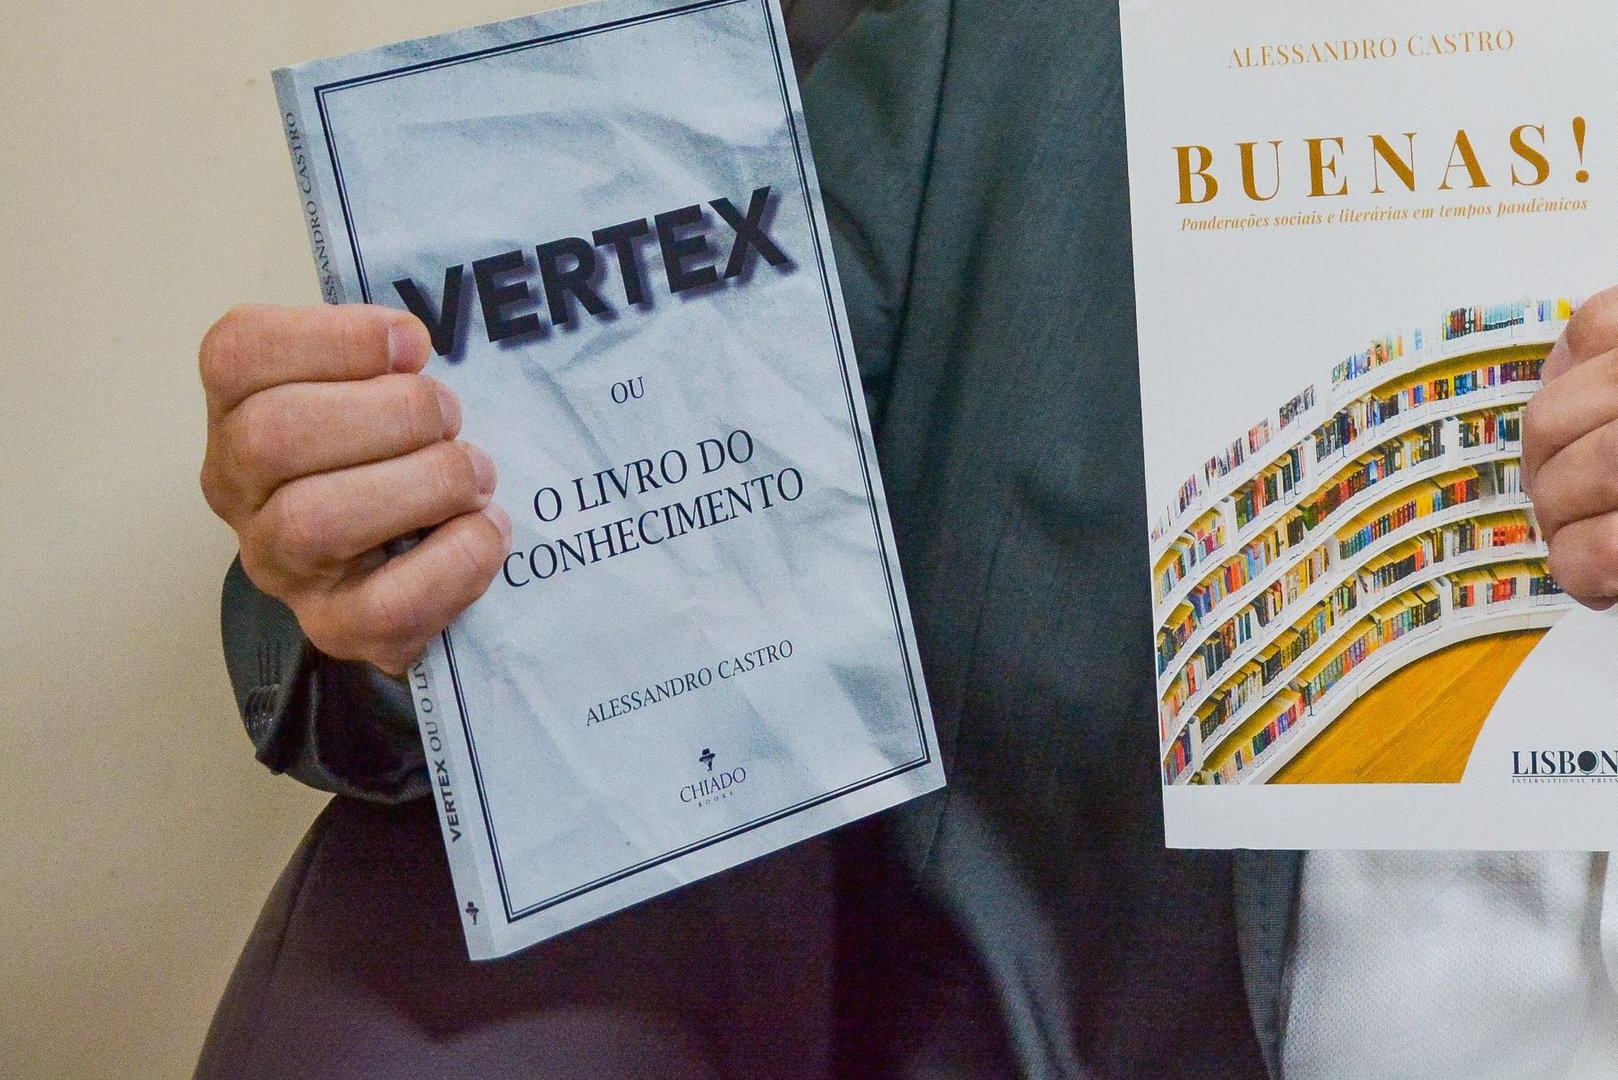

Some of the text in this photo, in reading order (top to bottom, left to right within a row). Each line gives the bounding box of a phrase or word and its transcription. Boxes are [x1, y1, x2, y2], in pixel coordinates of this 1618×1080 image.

[1228, 28, 1515, 70] ALESSANDRO CASTRO
[1172, 115, 1591, 205] BUENAS!
[285, 111, 339, 305] ESSANDRO CASTRO
[1181, 196, 1589, 232] Ponderações sociais e literárias em tempos pandêmicos
[391, 185, 792, 358] VERTEX
[610, 375, 646, 404] OU
[533, 428, 755, 523] O LIVRO DO
[502, 466, 804, 588] CONHECIMENTO
[420, 697, 434, 715] O
[585, 638, 795, 727] ALESSANDRO CASTRO
[425, 722, 442, 753] OU
[1511, 749, 1618, 775] LISBON
[433, 758, 462, 843] VERTEX
[679, 766, 747, 804] CHIADO
